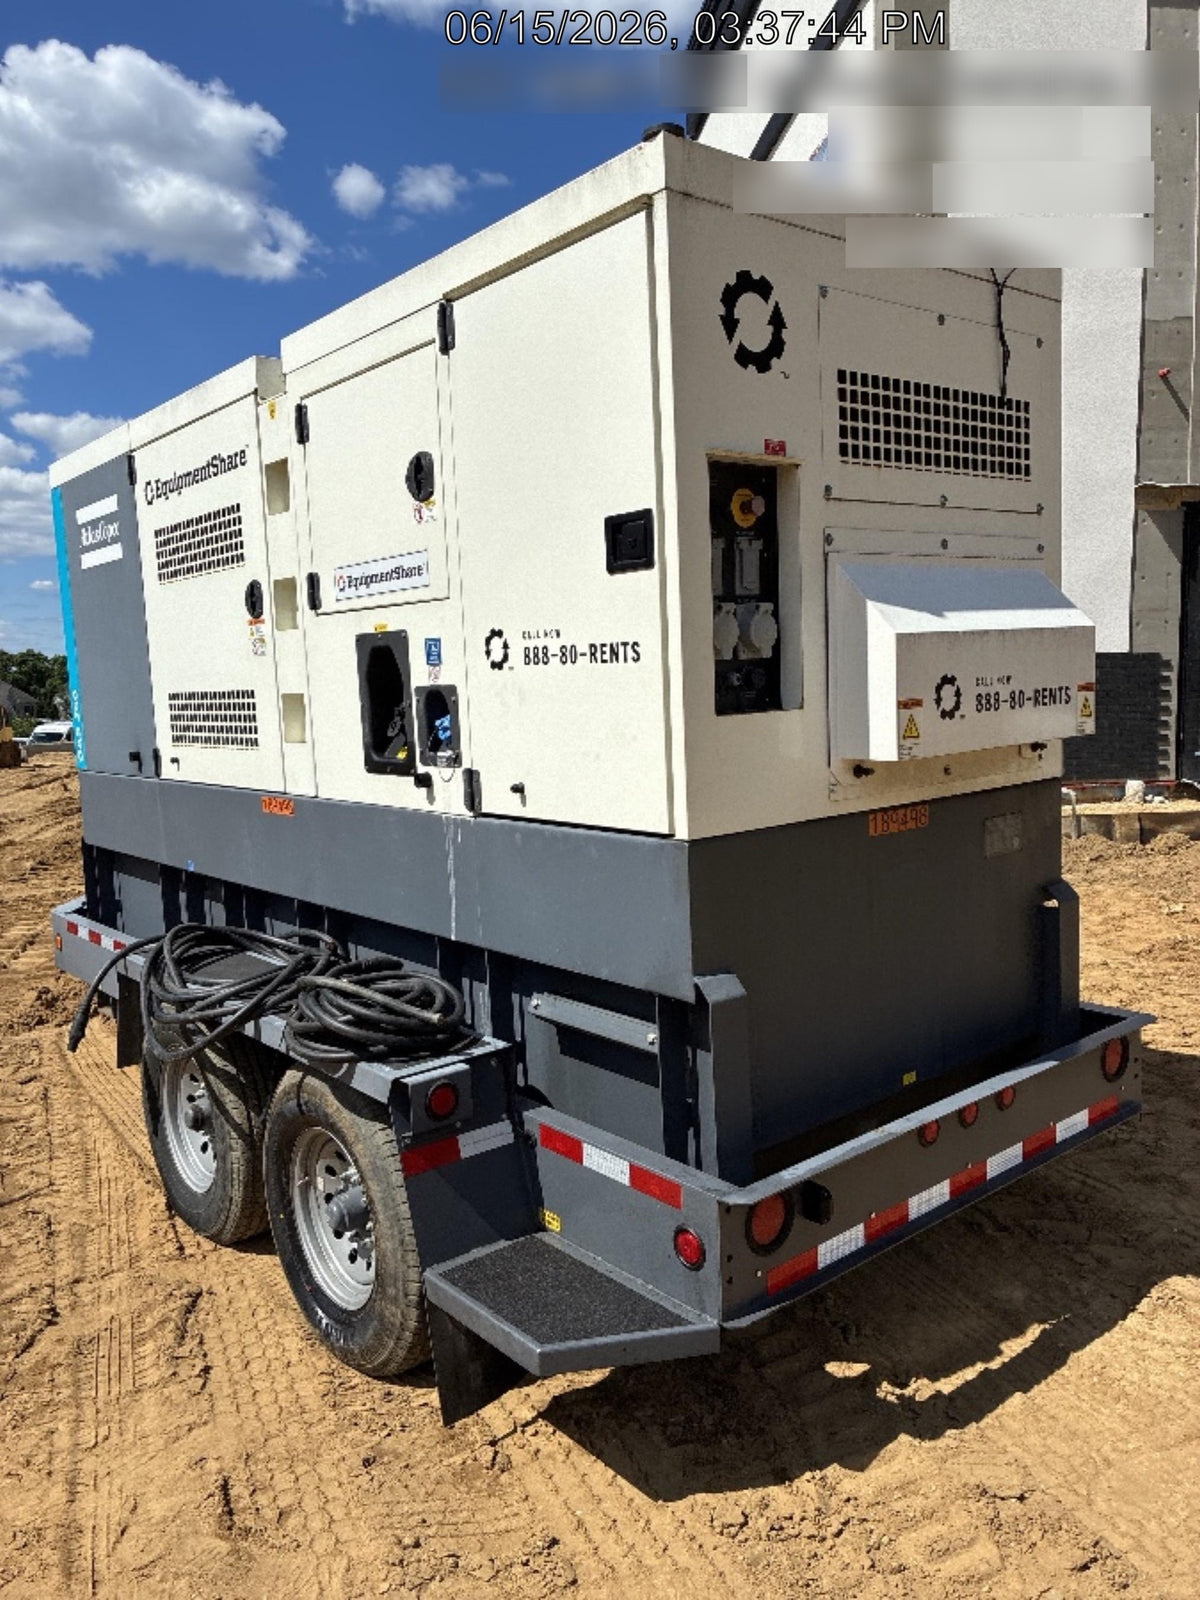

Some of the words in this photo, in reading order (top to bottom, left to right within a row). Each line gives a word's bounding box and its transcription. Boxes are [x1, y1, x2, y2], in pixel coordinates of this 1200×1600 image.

[153, 449, 248, 500] EquipmentShare
[346, 564, 424, 591] EquipmentShare
[523, 641, 641, 666] 888-80-RENTS
[974, 685, 1072, 713] 888-80-RENTS
